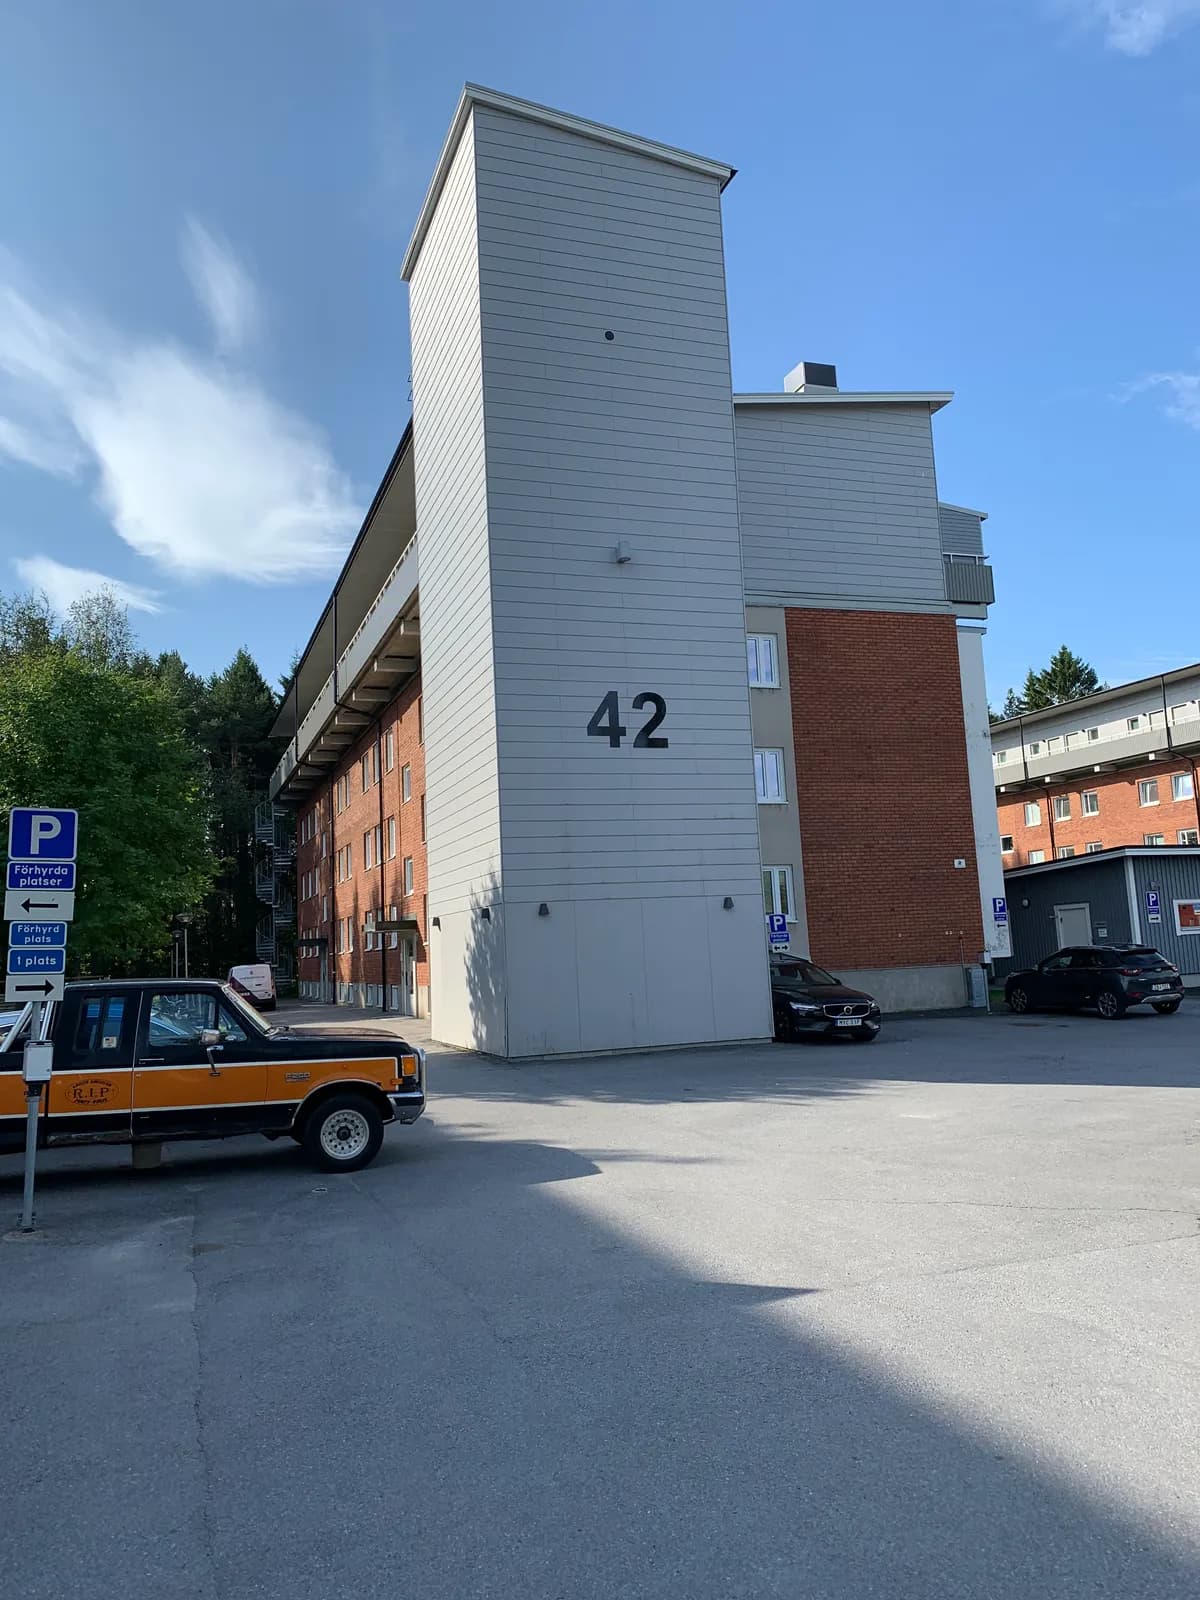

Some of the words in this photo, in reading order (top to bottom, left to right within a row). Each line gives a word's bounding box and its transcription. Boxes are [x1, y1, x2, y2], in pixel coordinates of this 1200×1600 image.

[587, 691, 669, 748] 42
[30, 815, 61, 855] P
[14, 865, 68, 877] Förhyrda
[20, 876, 62, 887] platser
[995, 899, 1004, 912] P
[1149, 893, 1157, 906] P
[773, 915, 783, 931] P
[17, 925, 60, 934] Förhyrd
[24, 935, 51, 945] plats
[17, 956, 21, 966] 1
[25, 956, 57, 967] plats
